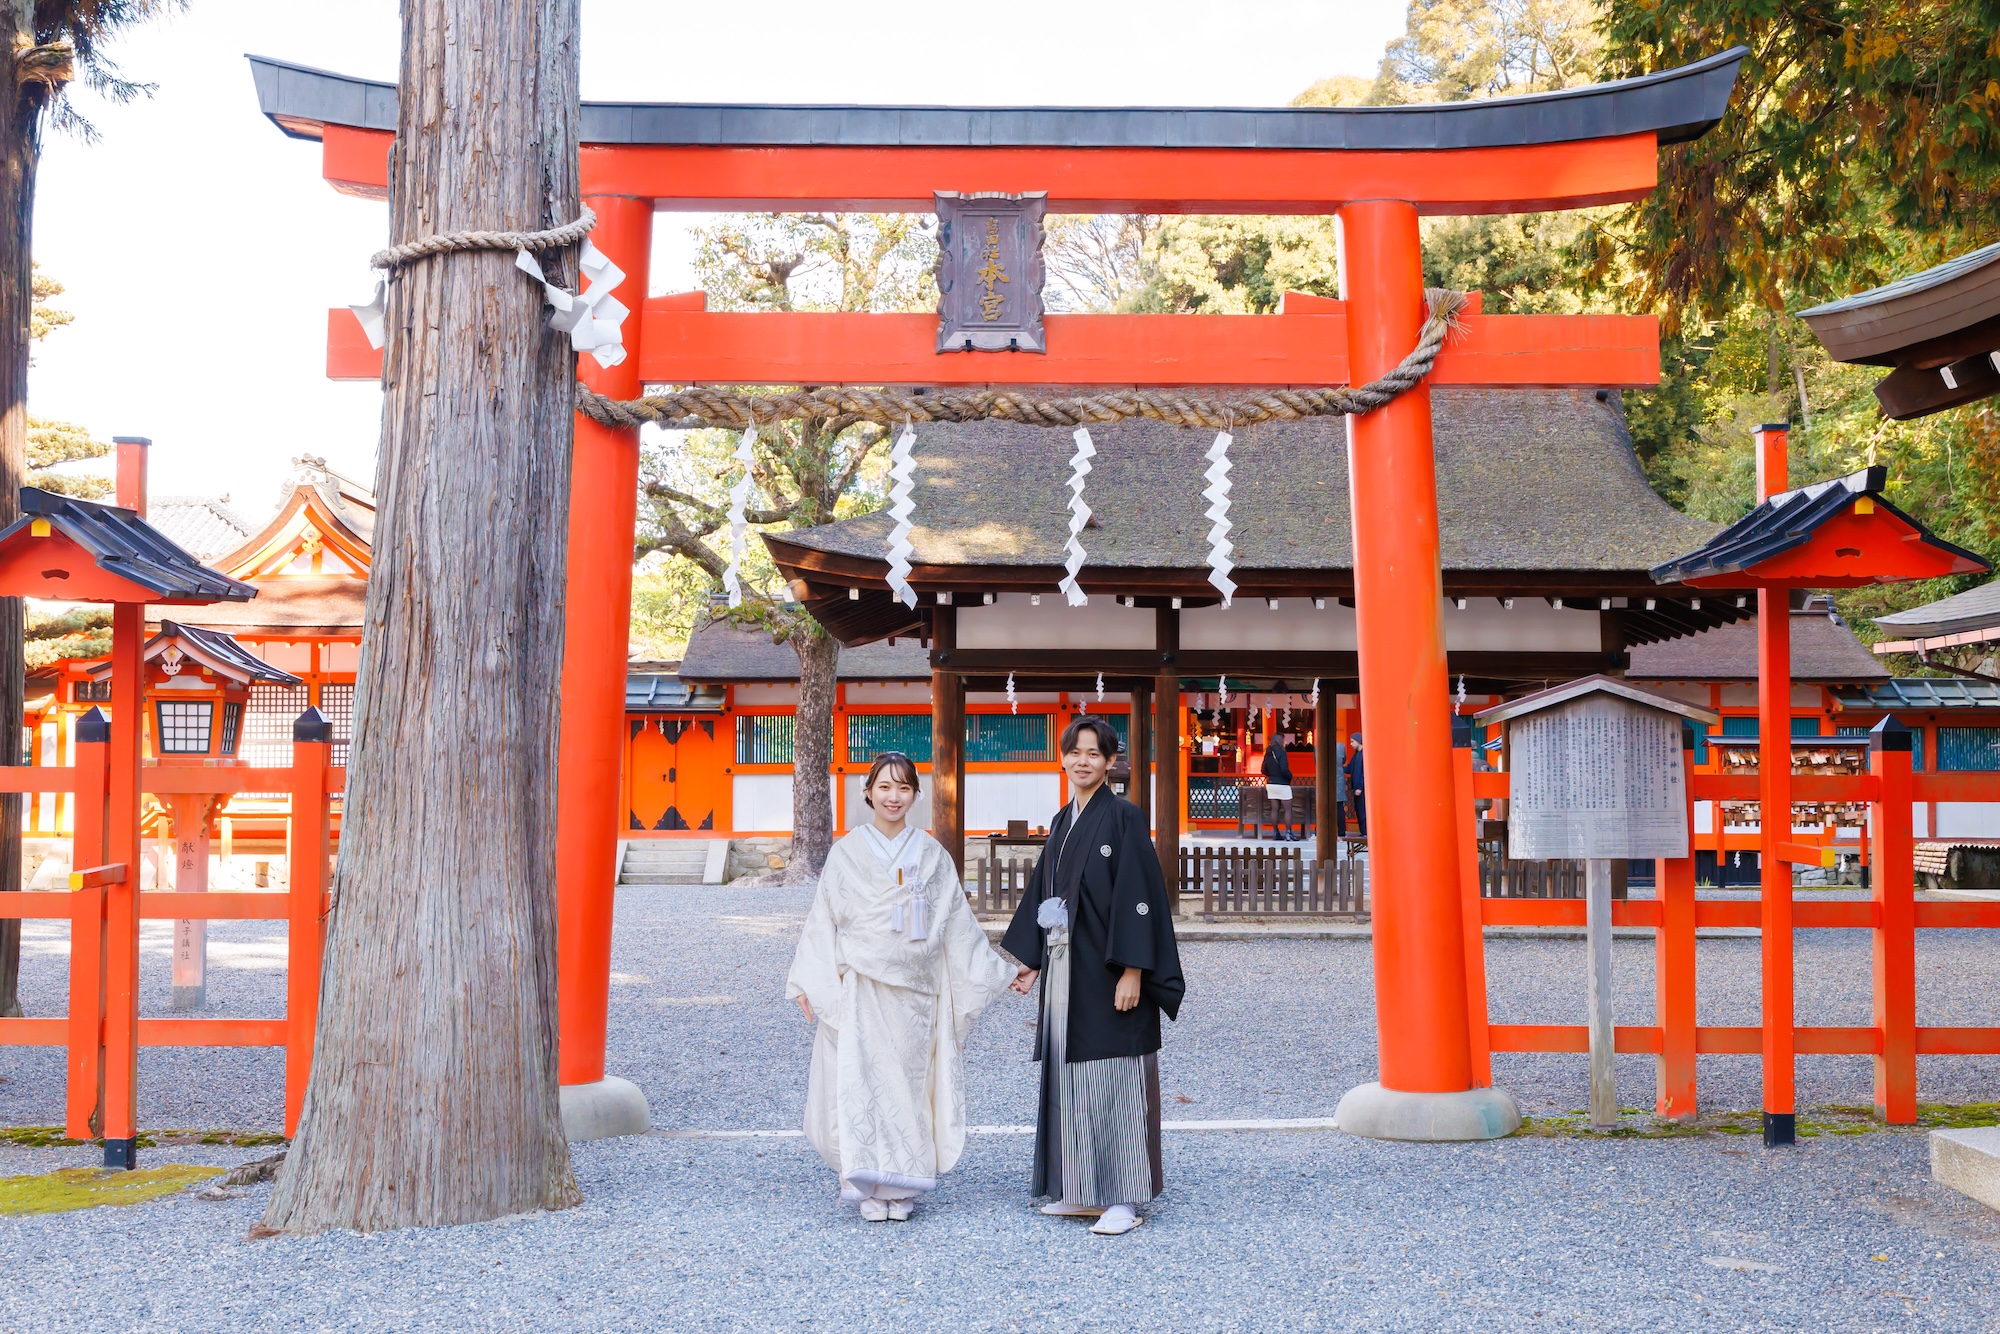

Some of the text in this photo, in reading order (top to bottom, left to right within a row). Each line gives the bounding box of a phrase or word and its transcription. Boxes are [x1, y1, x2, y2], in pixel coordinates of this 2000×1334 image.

[1670, 732, 1678, 783] 吉田神社
[182, 842, 195, 869] 献燈
